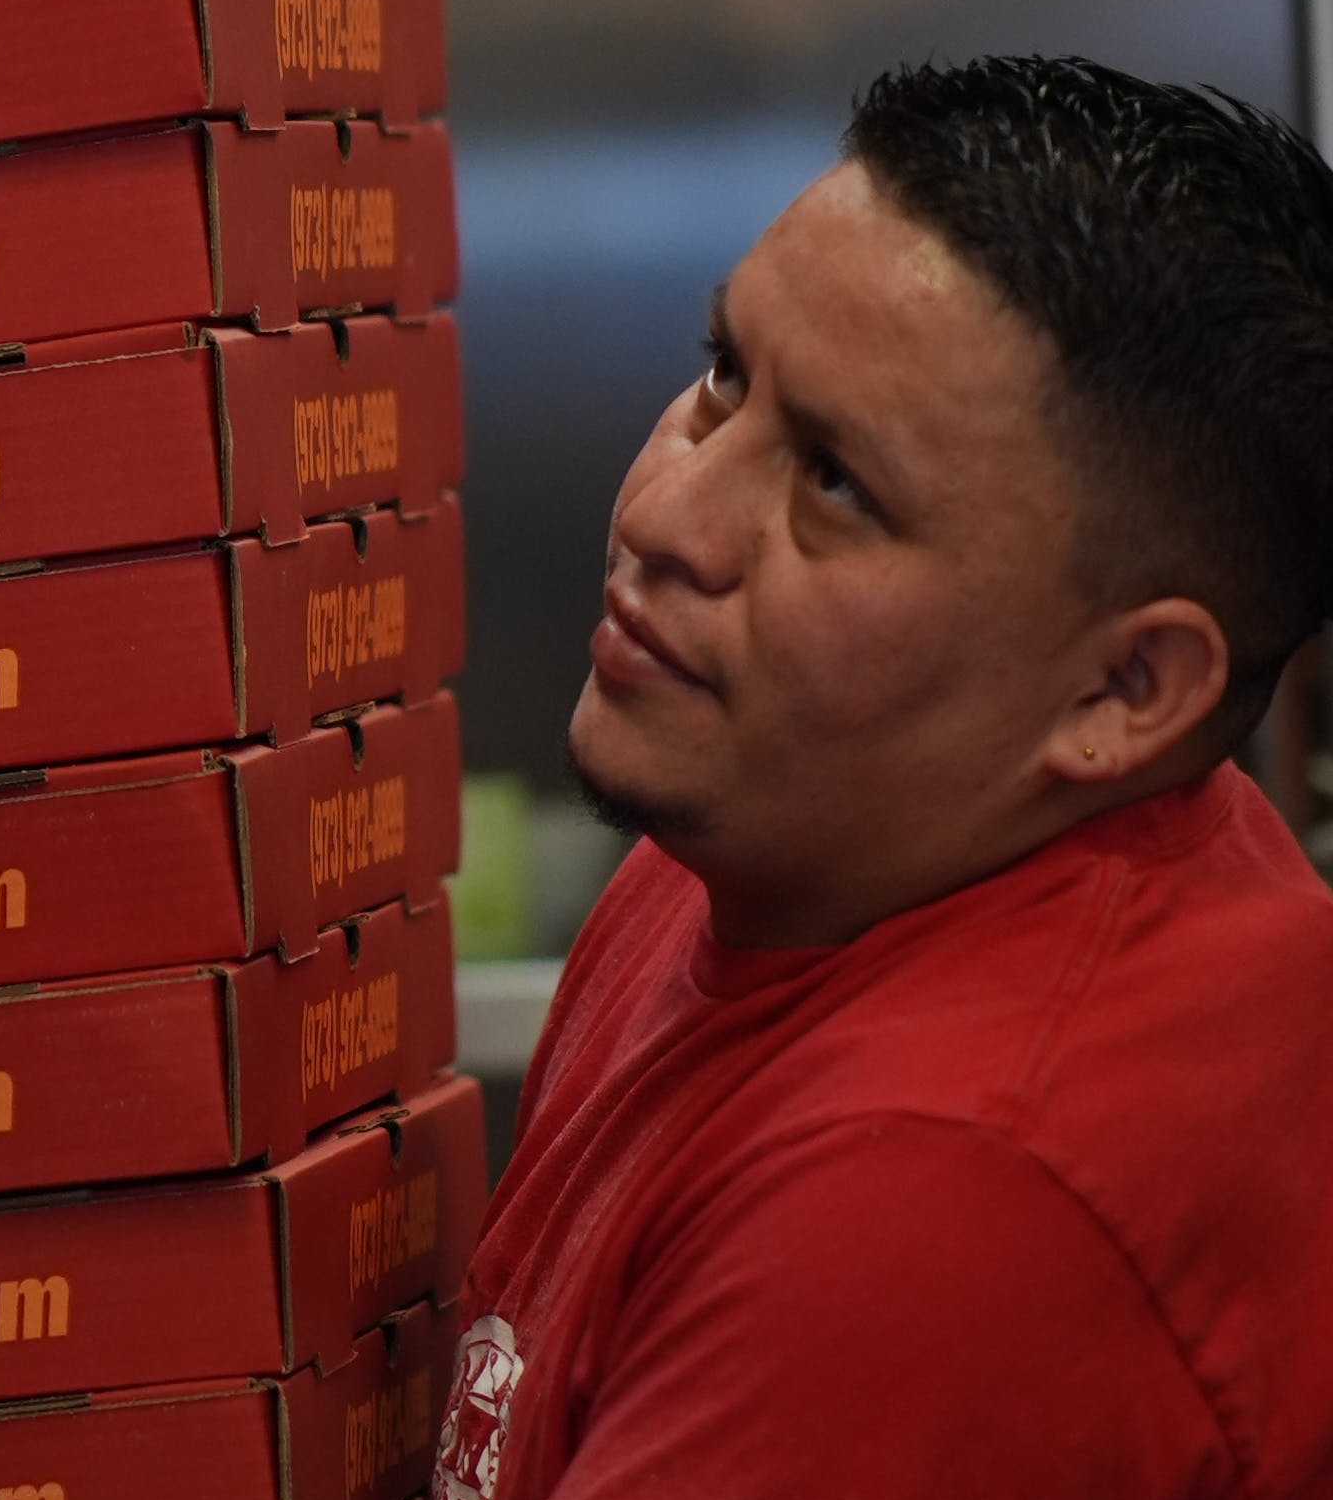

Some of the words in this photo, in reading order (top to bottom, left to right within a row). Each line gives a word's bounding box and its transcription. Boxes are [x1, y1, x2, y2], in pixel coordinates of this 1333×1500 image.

[291, 184, 328, 284] (973)
[294, 393, 330, 496] (973)
[307, 583, 342, 690] (973)
[310, 789, 344, 899] (973)
[301, 989, 336, 1103] (973)
[350, 1190, 381, 1303] (973)
